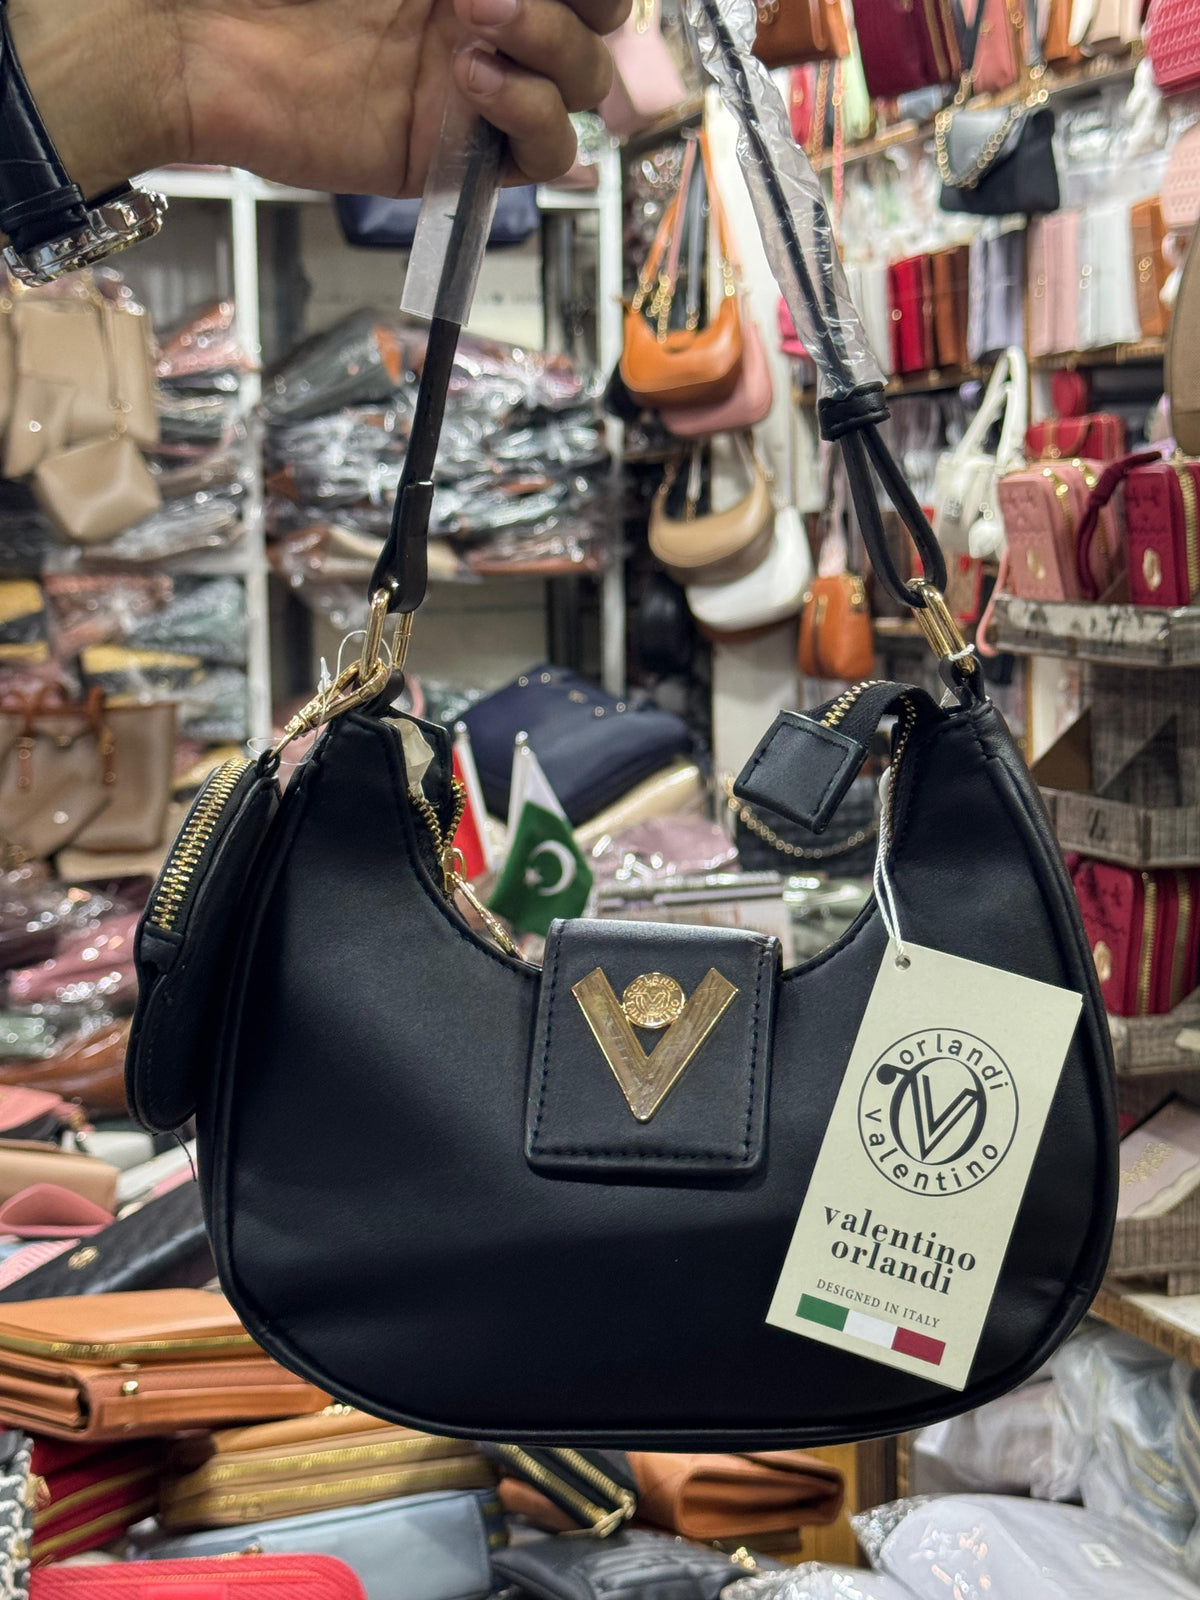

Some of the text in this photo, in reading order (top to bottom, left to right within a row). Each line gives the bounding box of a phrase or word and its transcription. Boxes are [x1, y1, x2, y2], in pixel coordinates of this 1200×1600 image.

[899, 1033, 1009, 1090] orlandi
[865, 1108, 998, 1191] valentino
[824, 1206, 976, 1271] valentino
[831, 1240, 953, 1295] orlandi
[816, 1278, 941, 1328] DESIGNED IN ITALY
